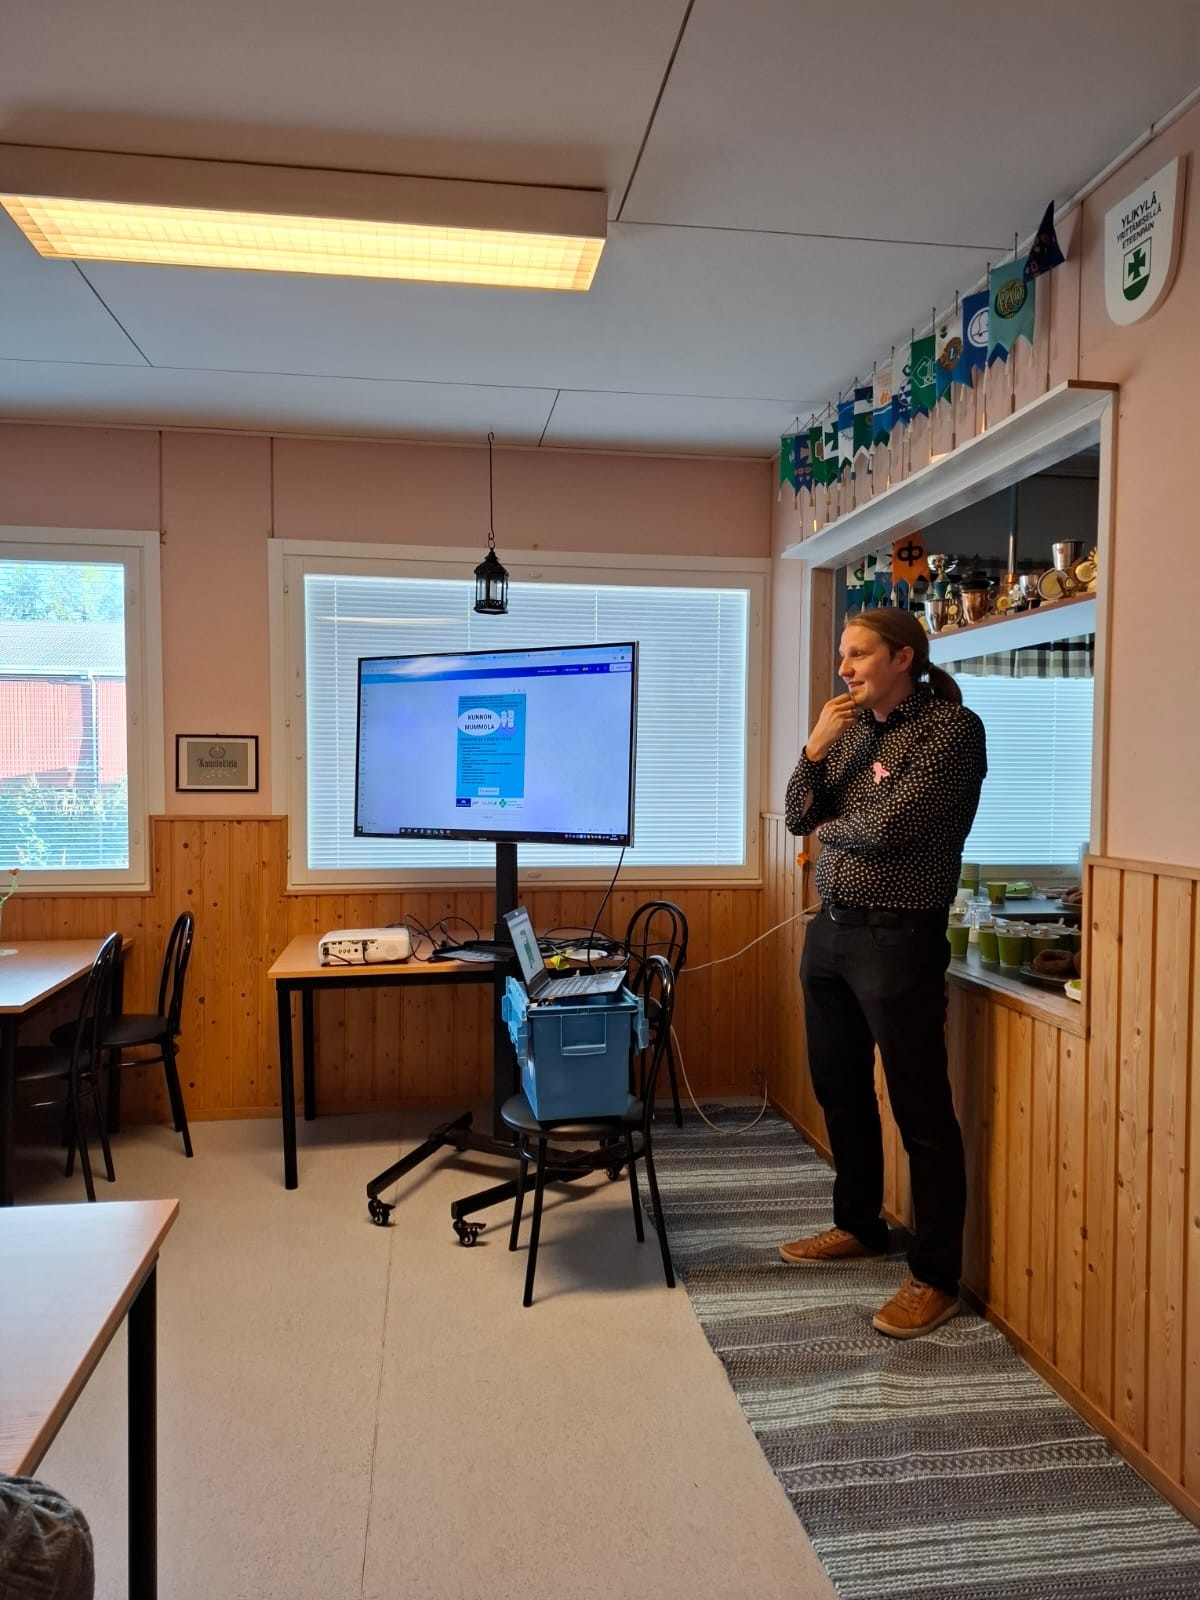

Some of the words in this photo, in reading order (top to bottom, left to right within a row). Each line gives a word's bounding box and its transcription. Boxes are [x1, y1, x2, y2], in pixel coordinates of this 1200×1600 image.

[1121, 191, 1156, 228] YLIKYLÄ
[1122, 221, 1154, 249] ETEENPÄIN
[467, 713, 492, 721] KUNNON
[464, 723, 495, 731] MUMMOLA
